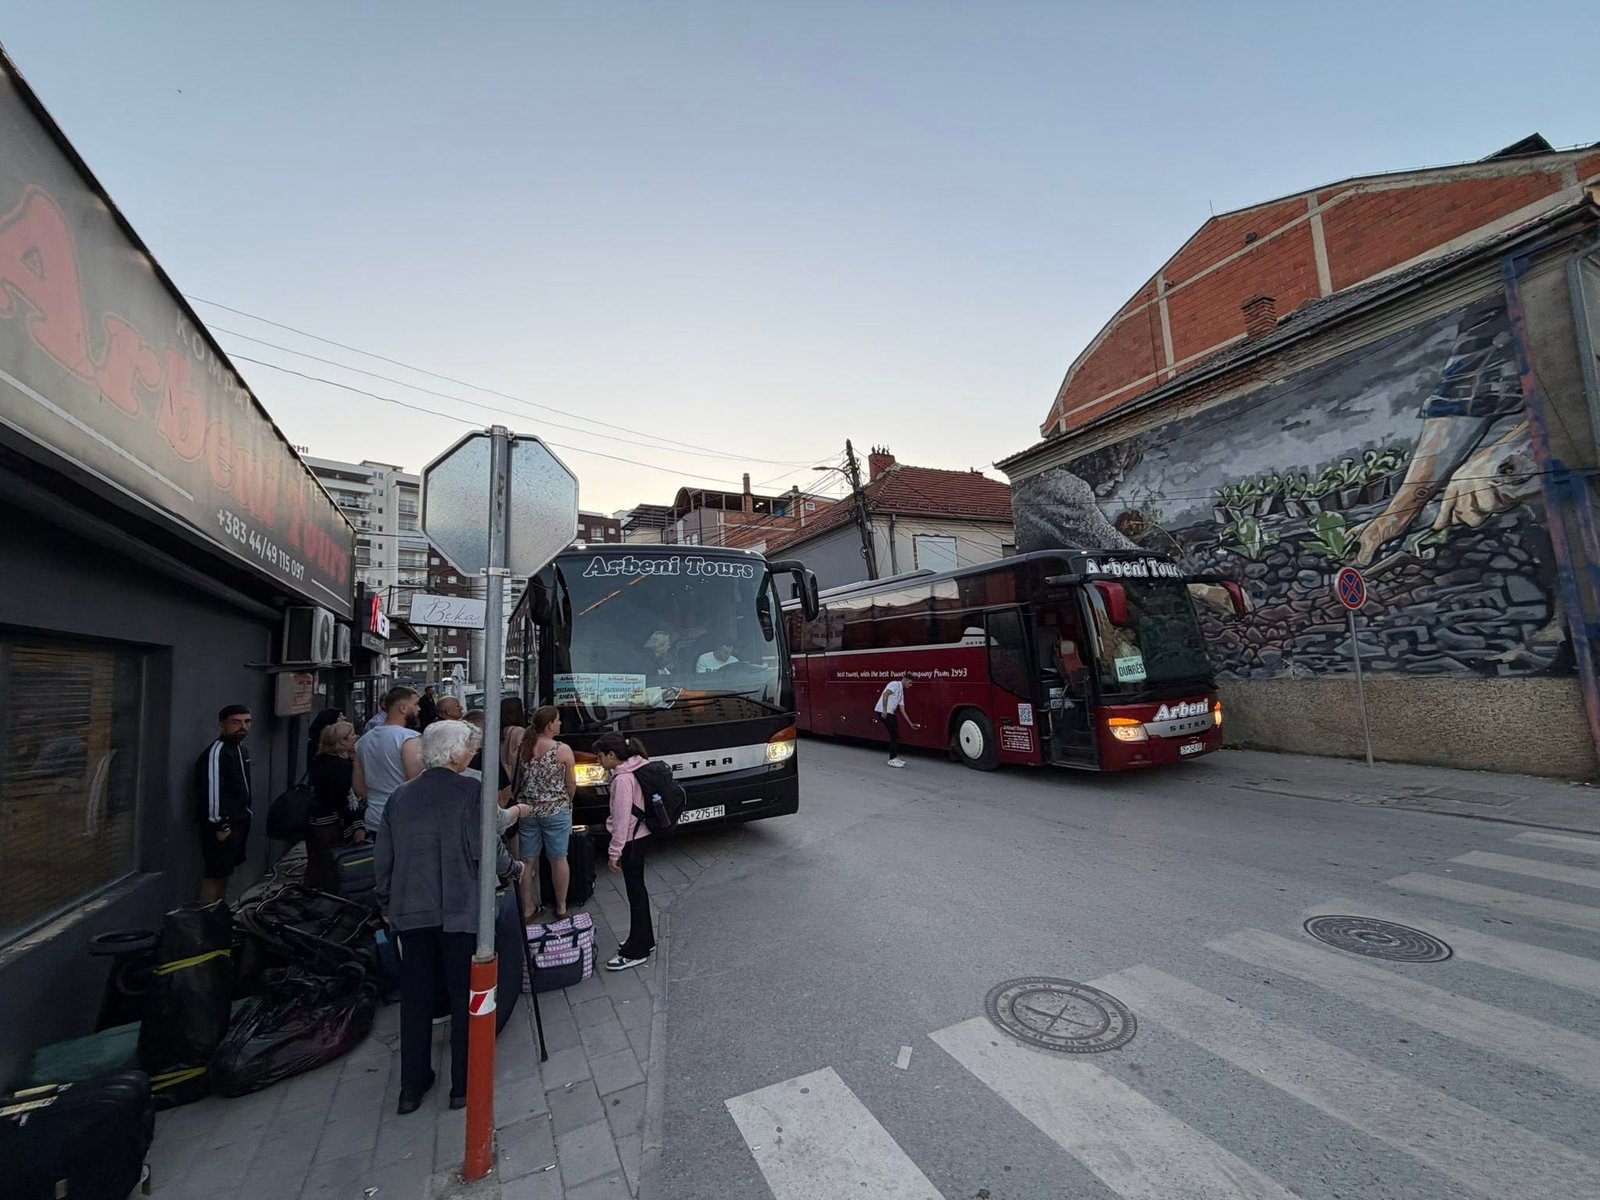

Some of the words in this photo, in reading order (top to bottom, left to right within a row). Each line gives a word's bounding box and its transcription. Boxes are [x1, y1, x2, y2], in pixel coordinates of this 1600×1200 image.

[217, 508, 247, 545] +383
[249, 530, 277, 564] 44/49
[279, 550, 290, 573] 115
[291, 560, 305, 581] 097
[583, 555, 680, 578] Arbeni
[685, 556, 754, 579] Tours
[1086, 557, 1148, 578] Arbeni
[1153, 697, 1209, 722] Arbeni
[1169, 720, 1206, 732] SETRA
[672, 757, 732, 771] ETRA
[695, 806, 723, 820] 275-FH
